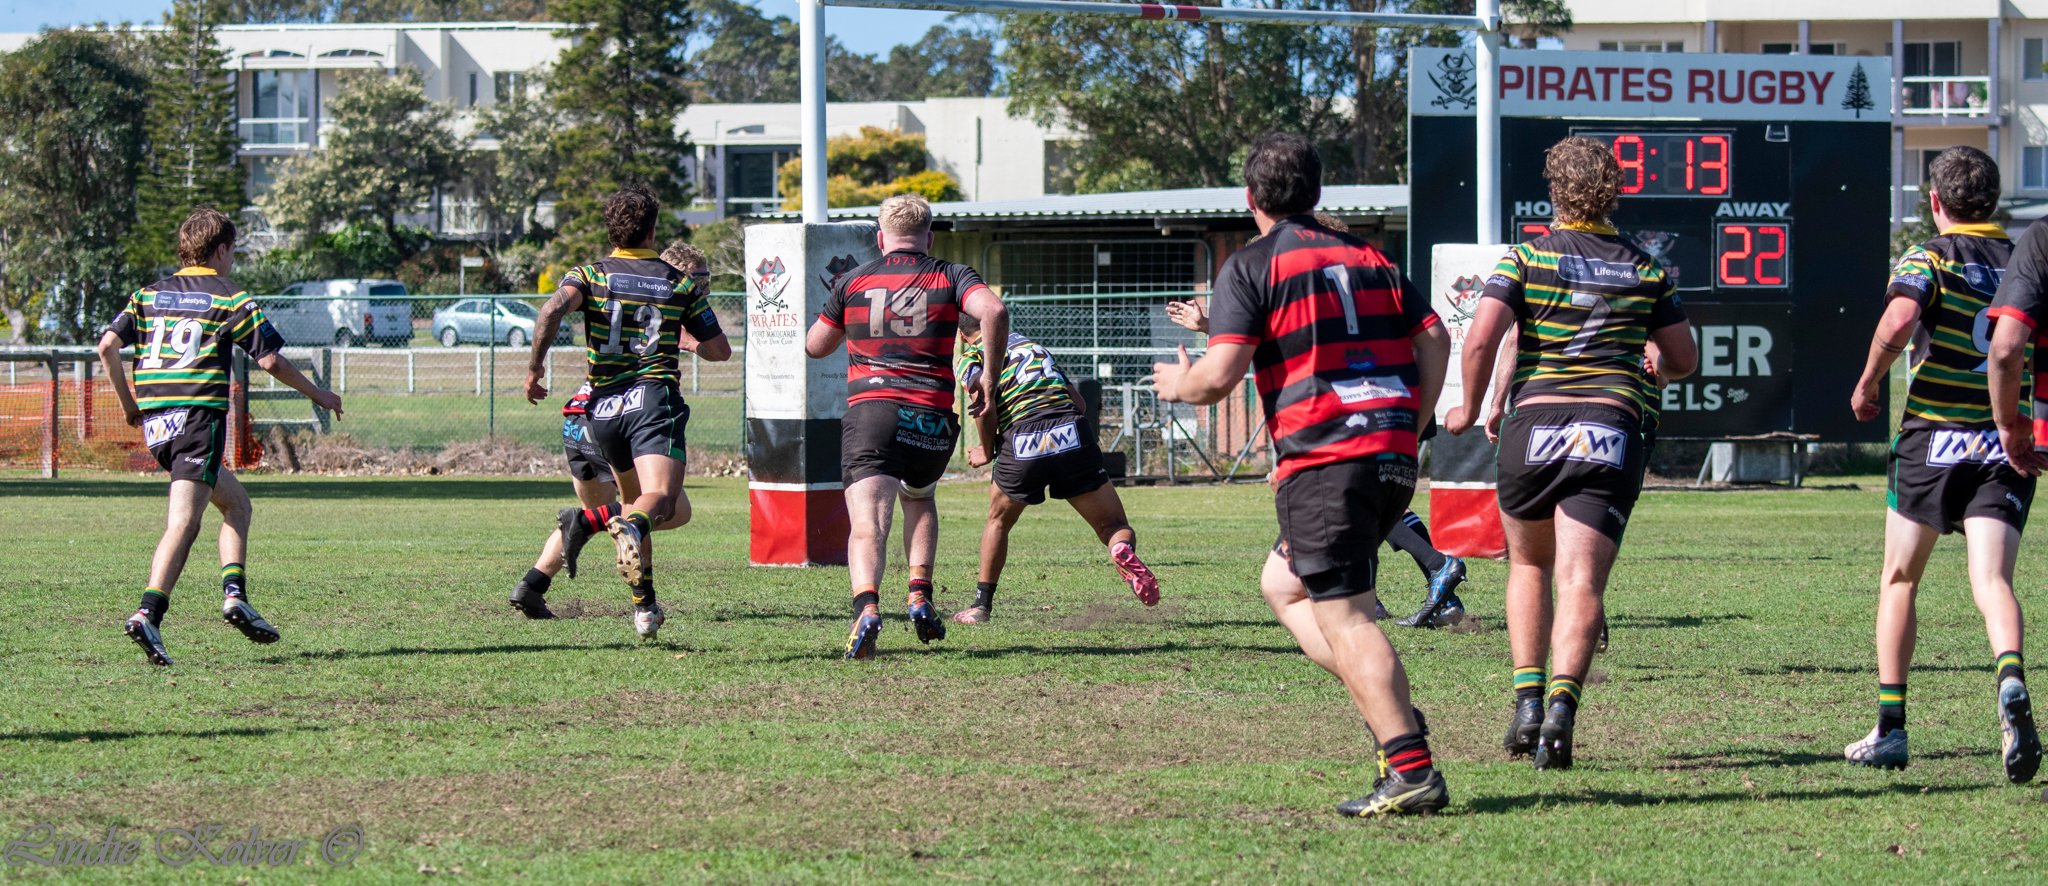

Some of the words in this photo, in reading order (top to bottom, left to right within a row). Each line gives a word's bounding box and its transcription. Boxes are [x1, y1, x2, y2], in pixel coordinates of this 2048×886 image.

[1499, 65, 1673, 103] PIRATES
[1687, 69, 1835, 105] RUGBY
[1715, 202, 1790, 217] AWAY
[885, 256, 917, 267] 1973
[1720, 226, 1785, 285] 22
[750, 313, 798, 330] PIRATES
[864, 287, 928, 338] 19
[1322, 264, 1359, 334] 1
[1560, 291, 1612, 358] 7
[142, 316, 204, 369] 19
[600, 300, 663, 356] 13
[1007, 344, 1066, 384] 22
